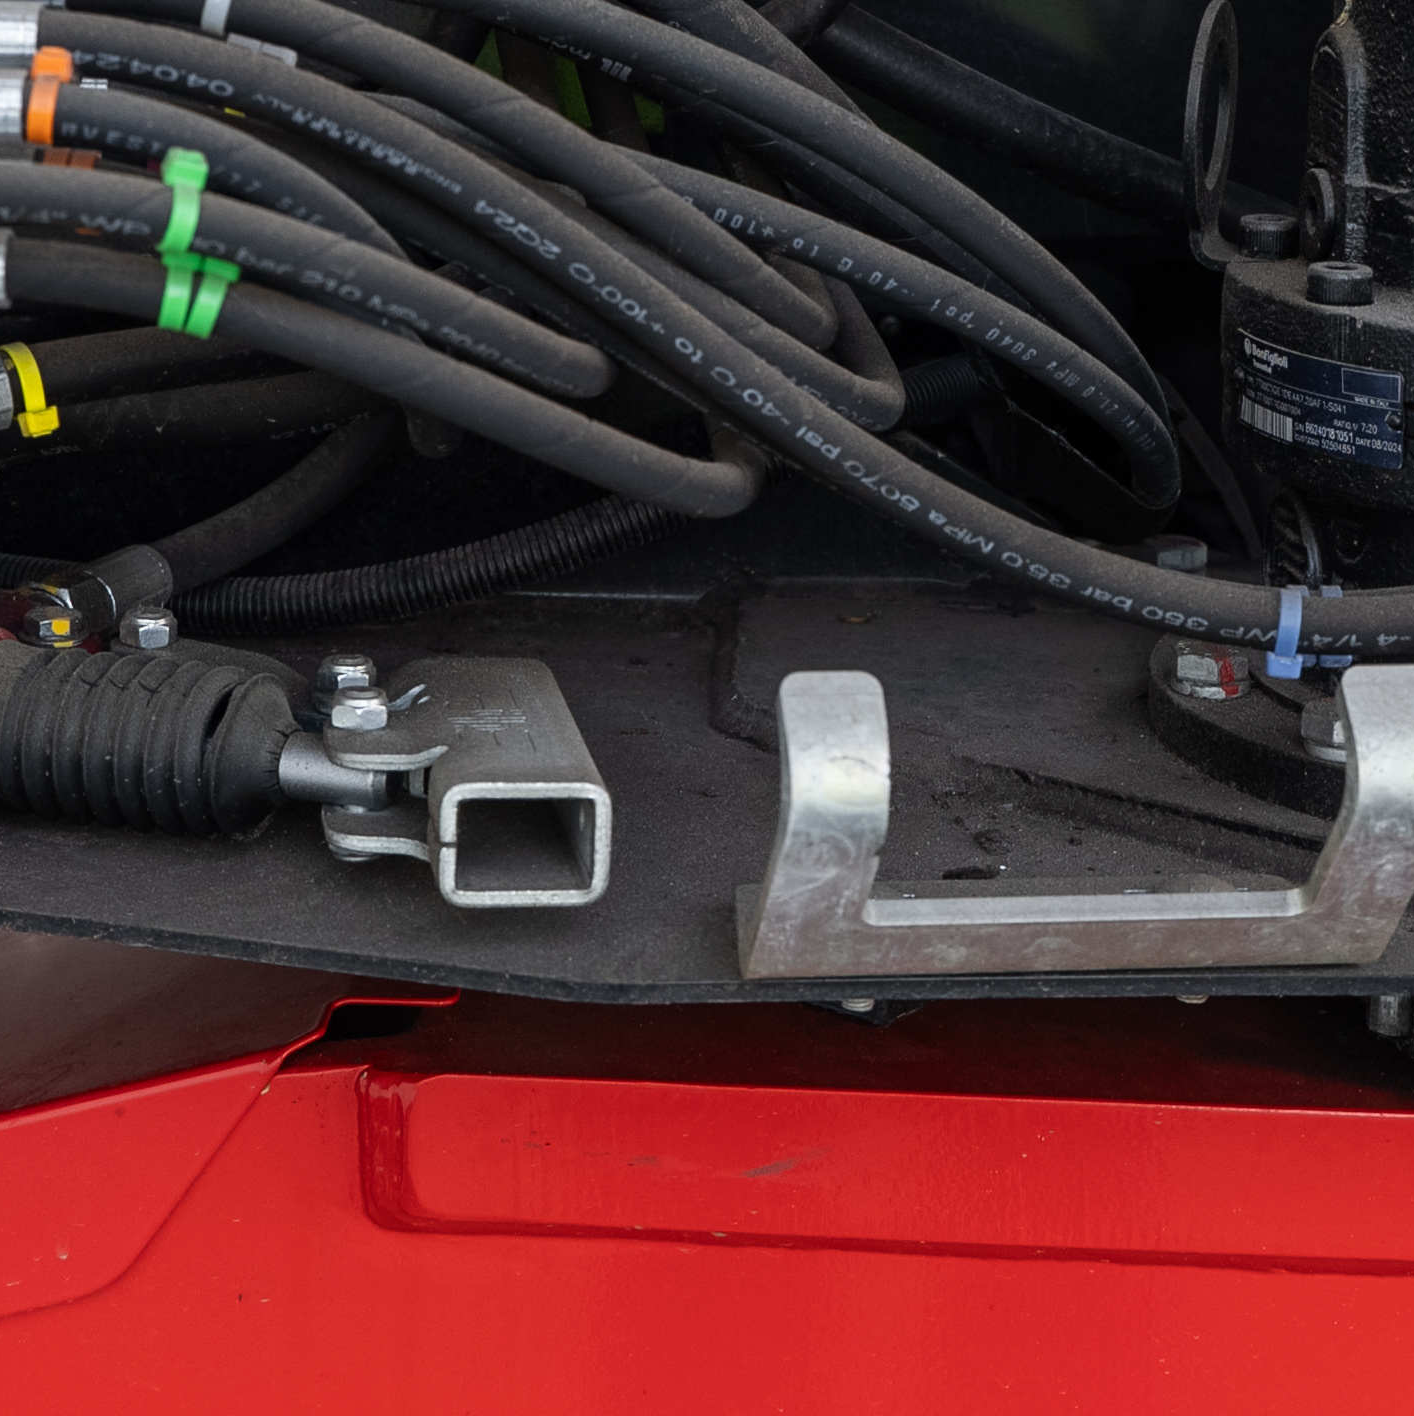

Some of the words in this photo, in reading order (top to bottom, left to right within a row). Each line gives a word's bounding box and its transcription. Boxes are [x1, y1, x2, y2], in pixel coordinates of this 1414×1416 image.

[73, 47, 235, 98] 04.04.24
[473, 197, 562, 262] 2Q24
[673, 334, 706, 365] to
[842, 458, 921, 514] 5070
[927, 507, 995, 555] MPa
[1000, 549, 1072, 591] 35.0
[1079, 585, 1135, 613] bar
[1141, 604, 1209, 633] 350
